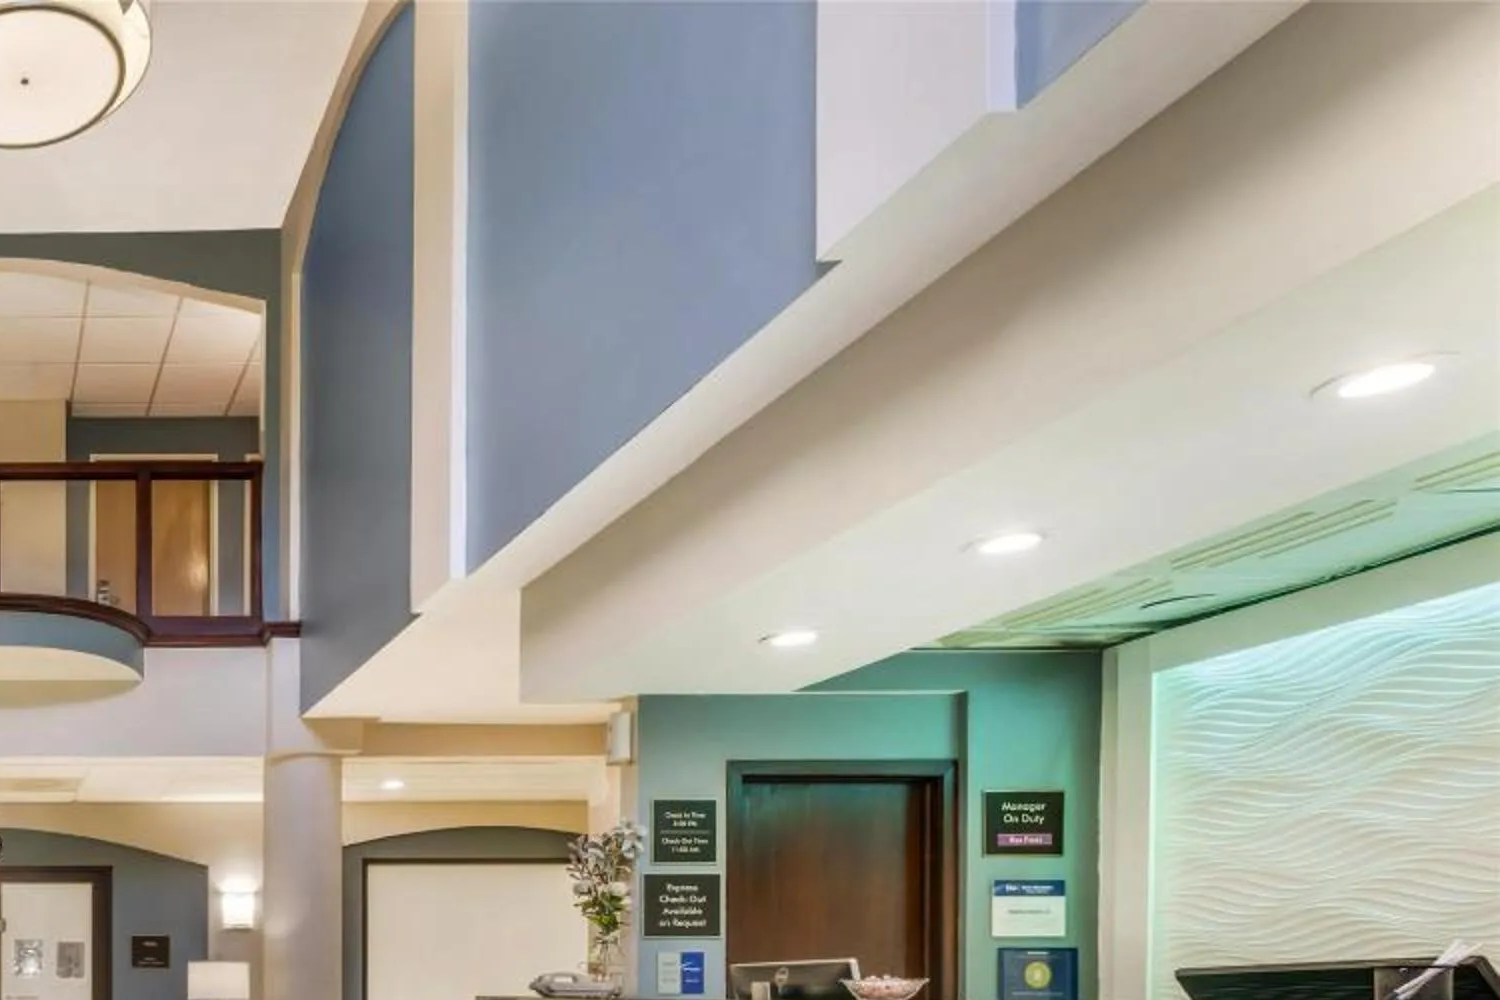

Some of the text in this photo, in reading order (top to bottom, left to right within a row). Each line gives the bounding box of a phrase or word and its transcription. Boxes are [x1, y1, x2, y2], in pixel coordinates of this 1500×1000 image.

[1001, 801, 1046, 813] Manager
[1003, 812, 1045, 825] On Duty
[662, 906, 704, 916] Available
[672, 918, 707, 929] Request
